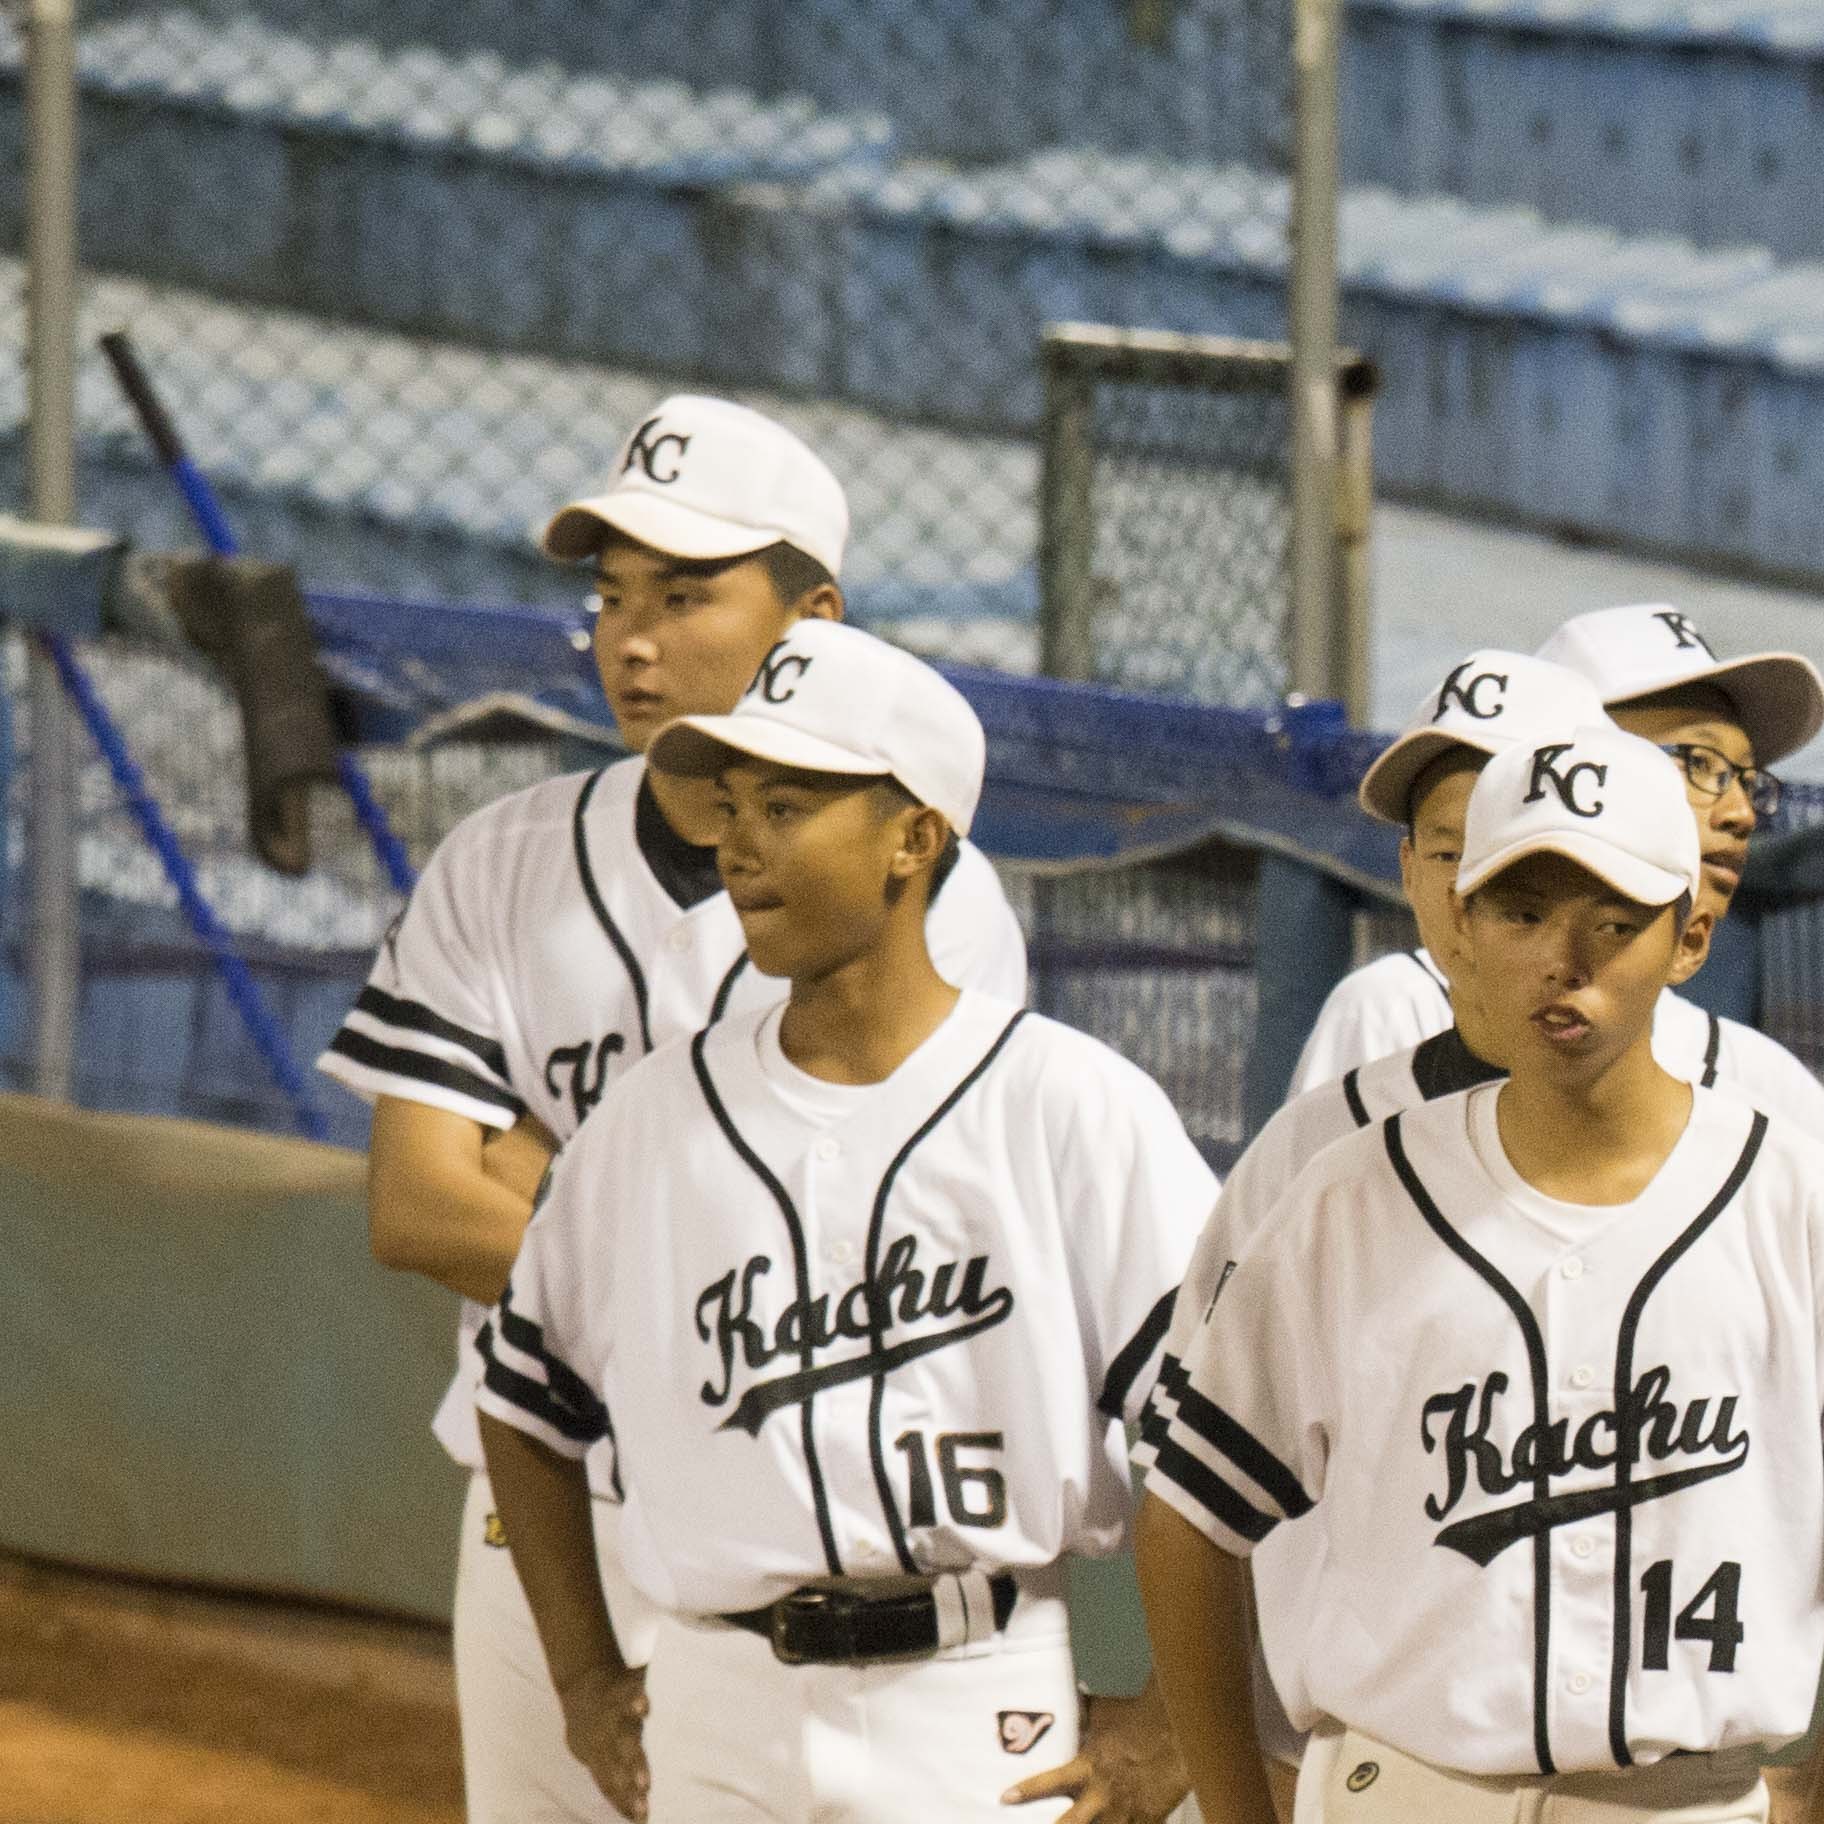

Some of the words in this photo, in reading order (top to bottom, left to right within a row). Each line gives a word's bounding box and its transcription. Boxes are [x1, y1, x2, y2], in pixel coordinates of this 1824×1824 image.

[1651, 612, 1719, 662] K
[1433, 660, 1508, 720] KC
[1522, 743, 1607, 818] KC
[696, 1234, 1013, 1406] Kachu
[894, 1430, 1007, 1529] 16
[1421, 1365, 1750, 1522] Kachu
[1640, 1559, 1744, 1673] 14
